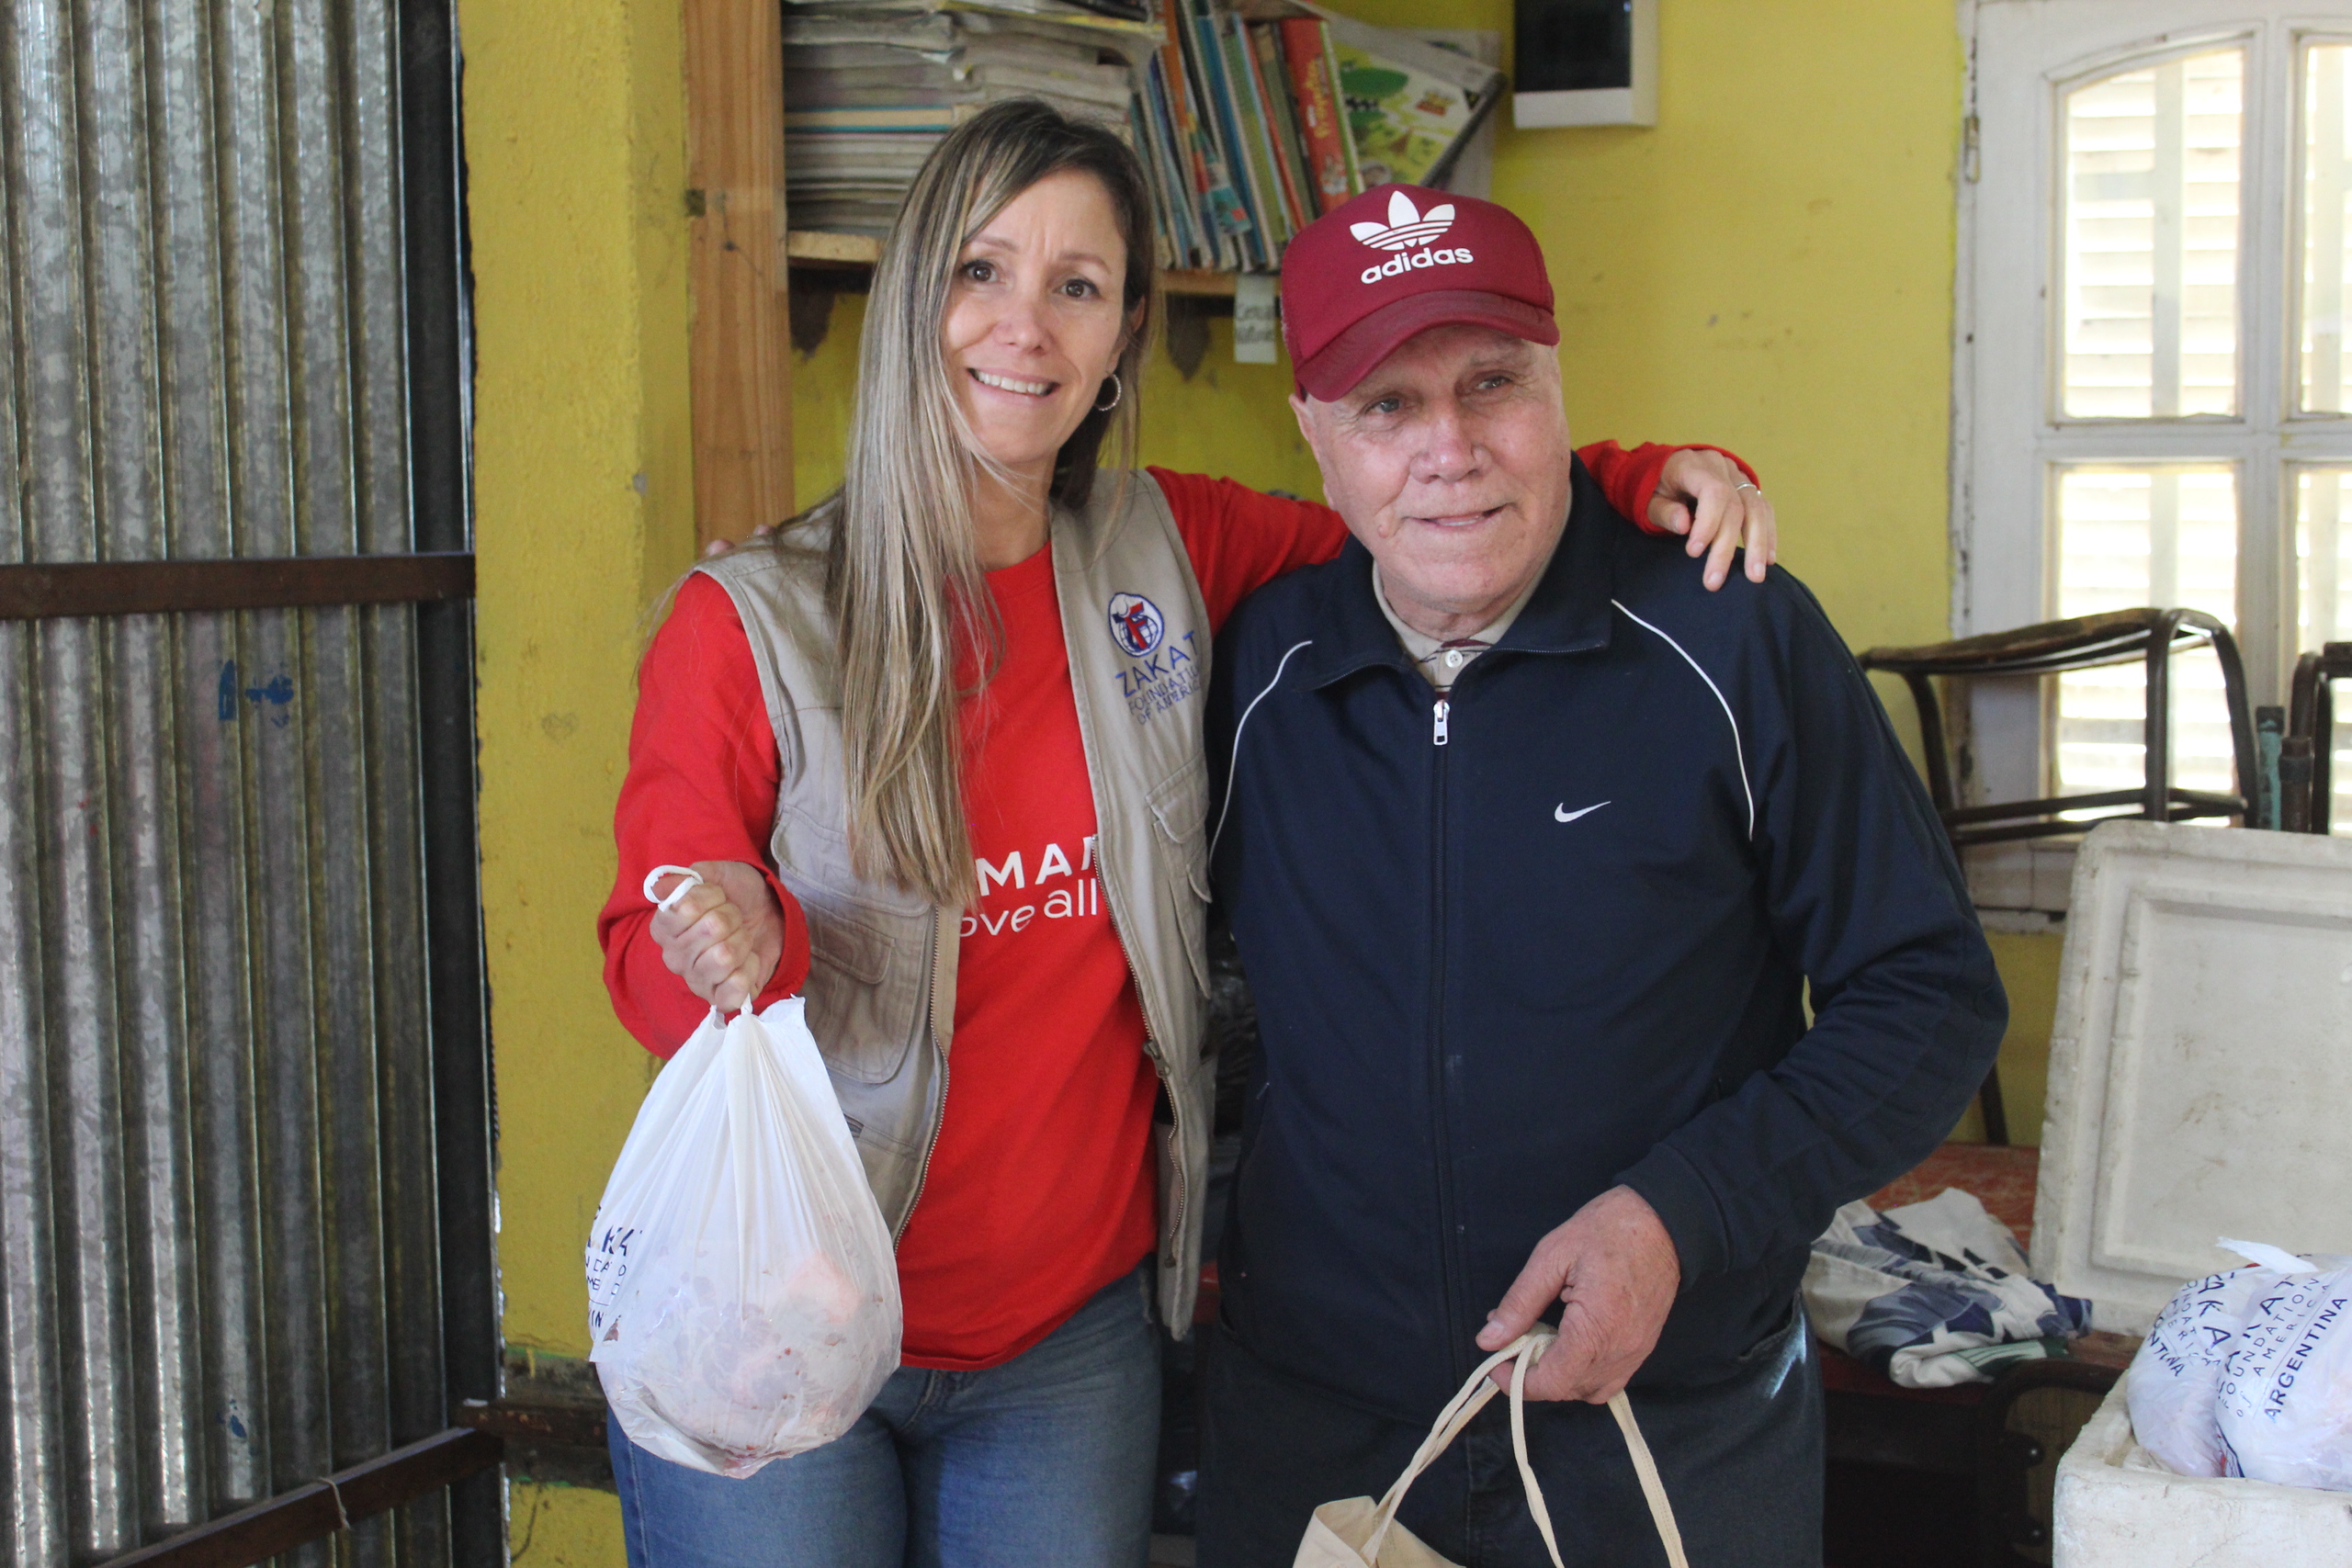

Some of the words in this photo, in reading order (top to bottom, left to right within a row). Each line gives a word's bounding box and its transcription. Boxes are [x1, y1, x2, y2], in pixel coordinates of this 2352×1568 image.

[1361, 247, 1474, 284] adidas
[1114, 630, 1198, 698] ZAKAT
[1044, 878, 1097, 919] all
[2264, 1298, 2348, 1424] ARGENTINA
